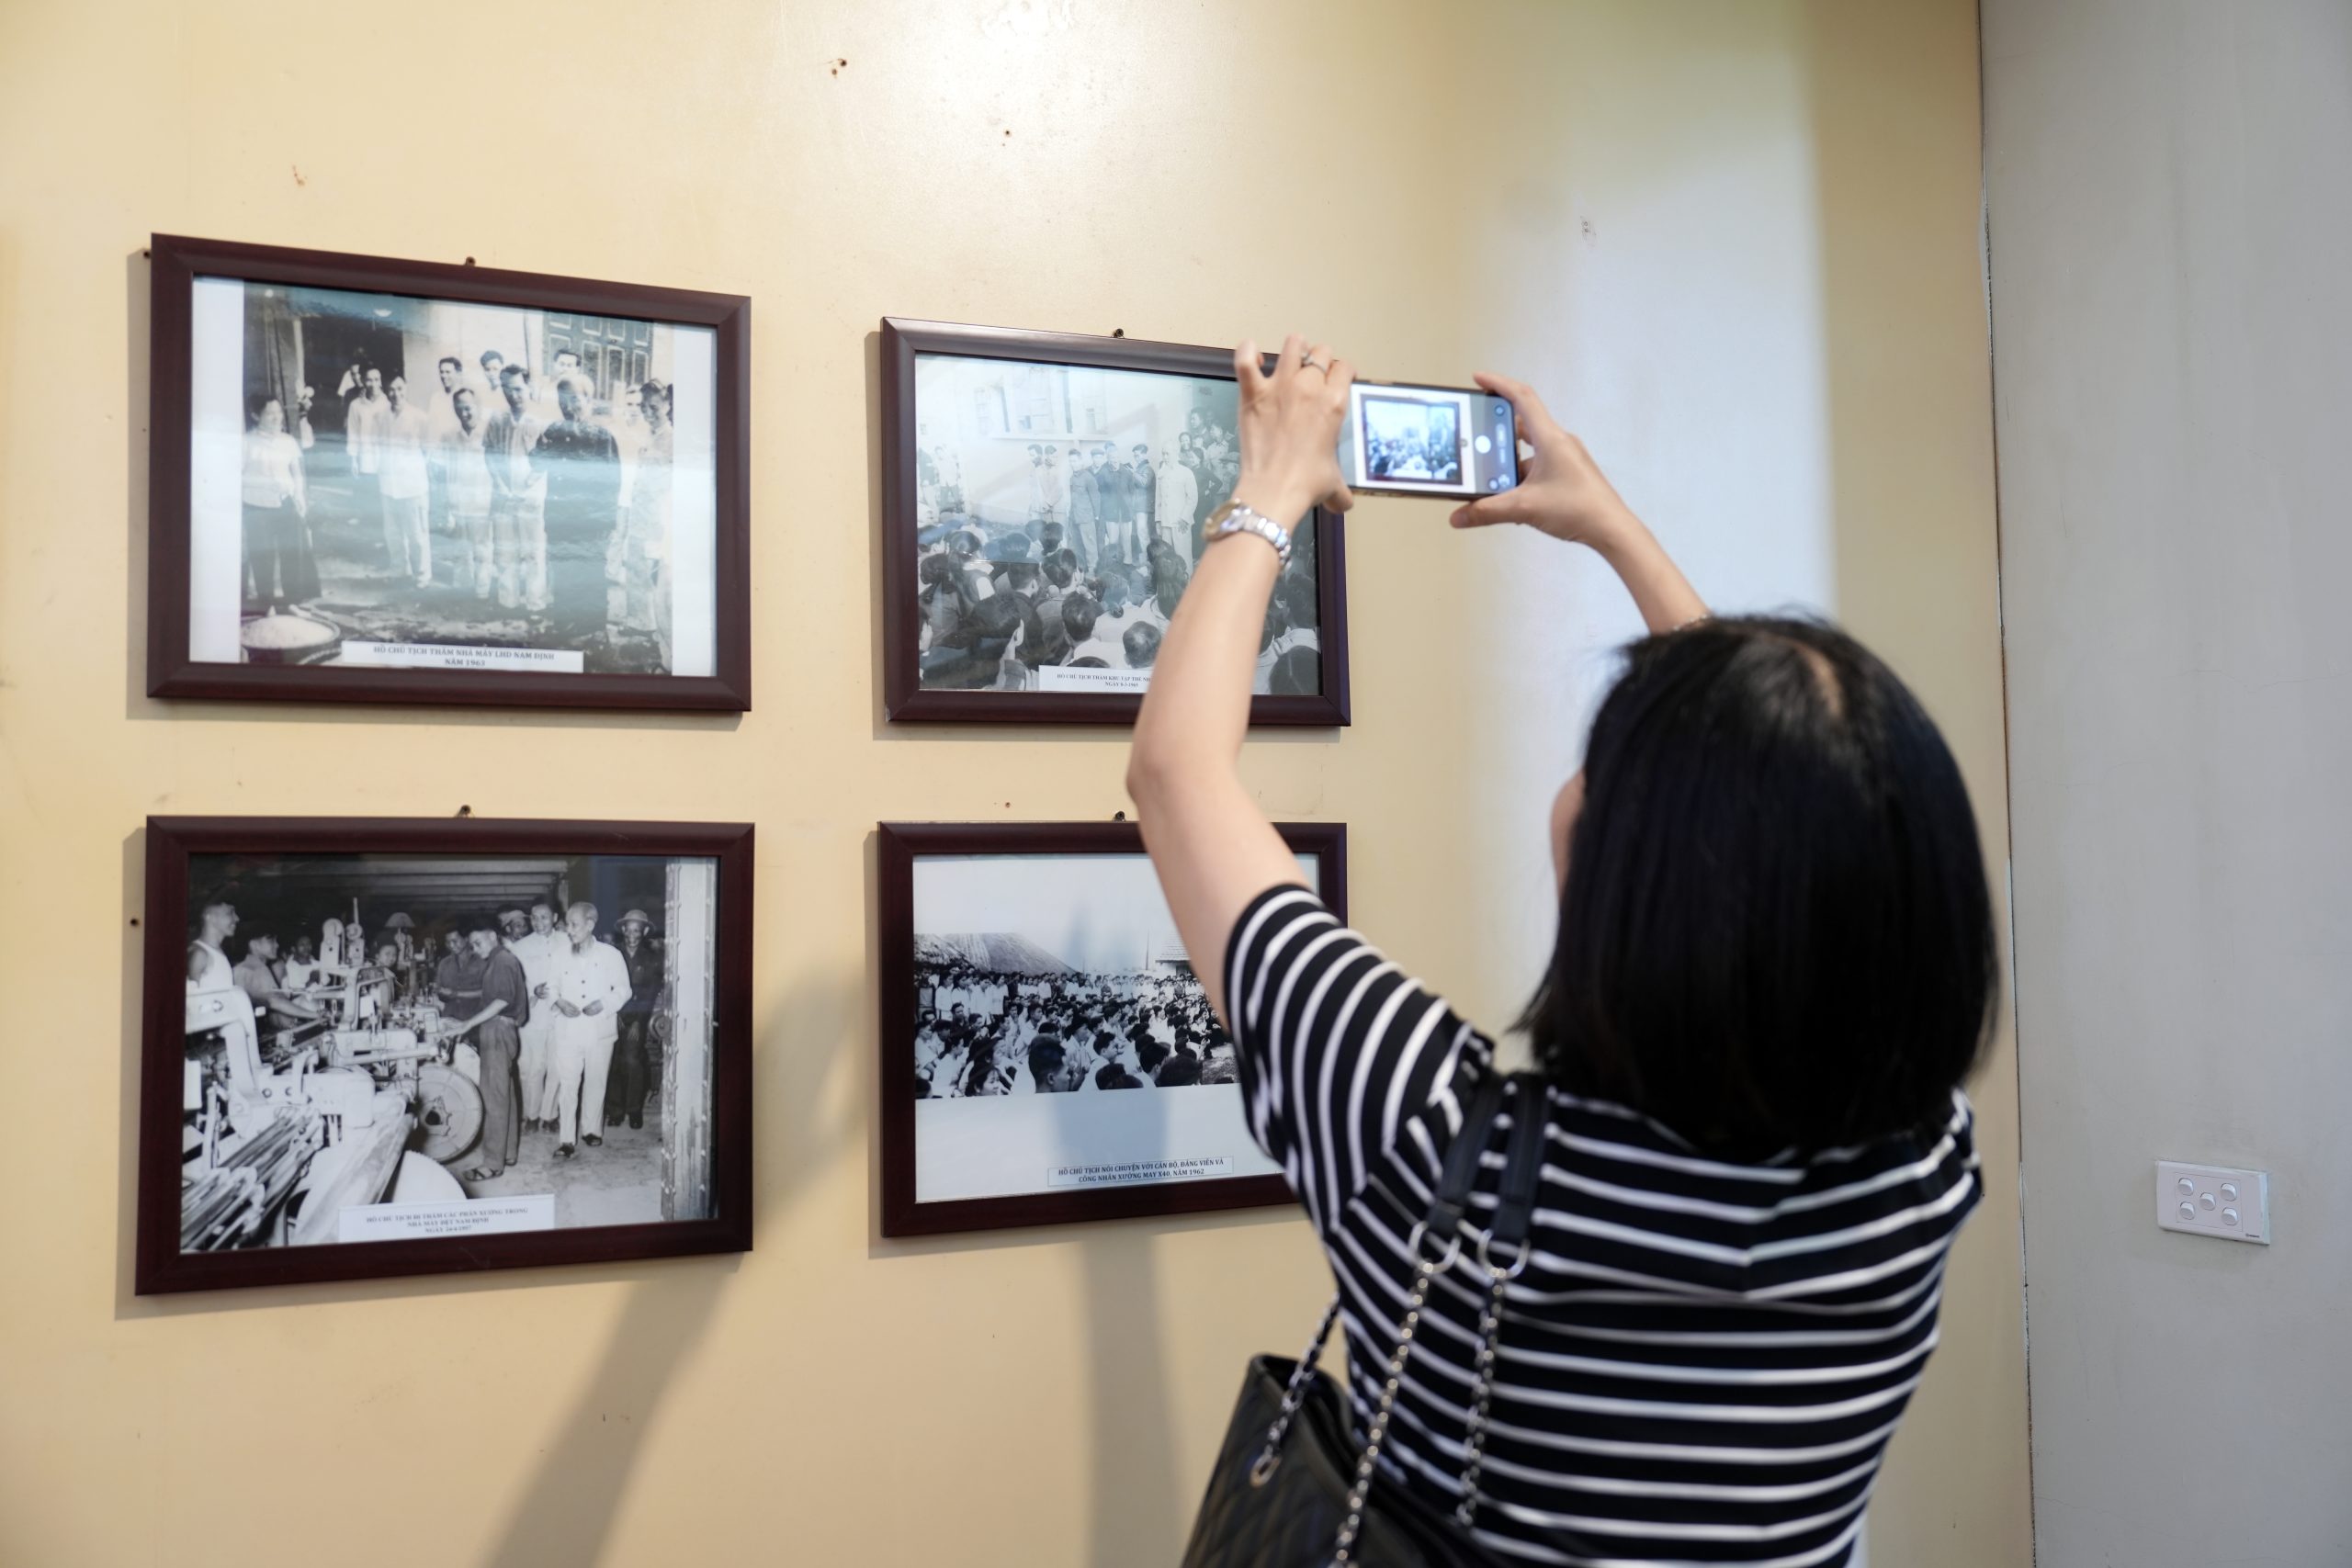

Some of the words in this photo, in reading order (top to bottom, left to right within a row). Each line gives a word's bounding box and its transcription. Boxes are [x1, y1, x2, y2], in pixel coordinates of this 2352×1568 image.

[1058, 1167, 1069, 1176] HỒ
[1069, 1166, 1083, 1175] CHỦ
[1085, 1166, 1101, 1176] TỊCH
[1102, 1164, 1114, 1173] NÓI
[1114, 1162, 1140, 1172] CHUYỆN
[1141, 1161, 1154, 1170] VỚI
[1079, 1173, 1097, 1183] CÔNG
[1098, 1173, 1117, 1182] NHÂN
[1143, 1170, 1157, 1179] MAY
[1172, 1168, 1188, 1177] NĂM
[1189, 1168, 1204, 1176] 1962
